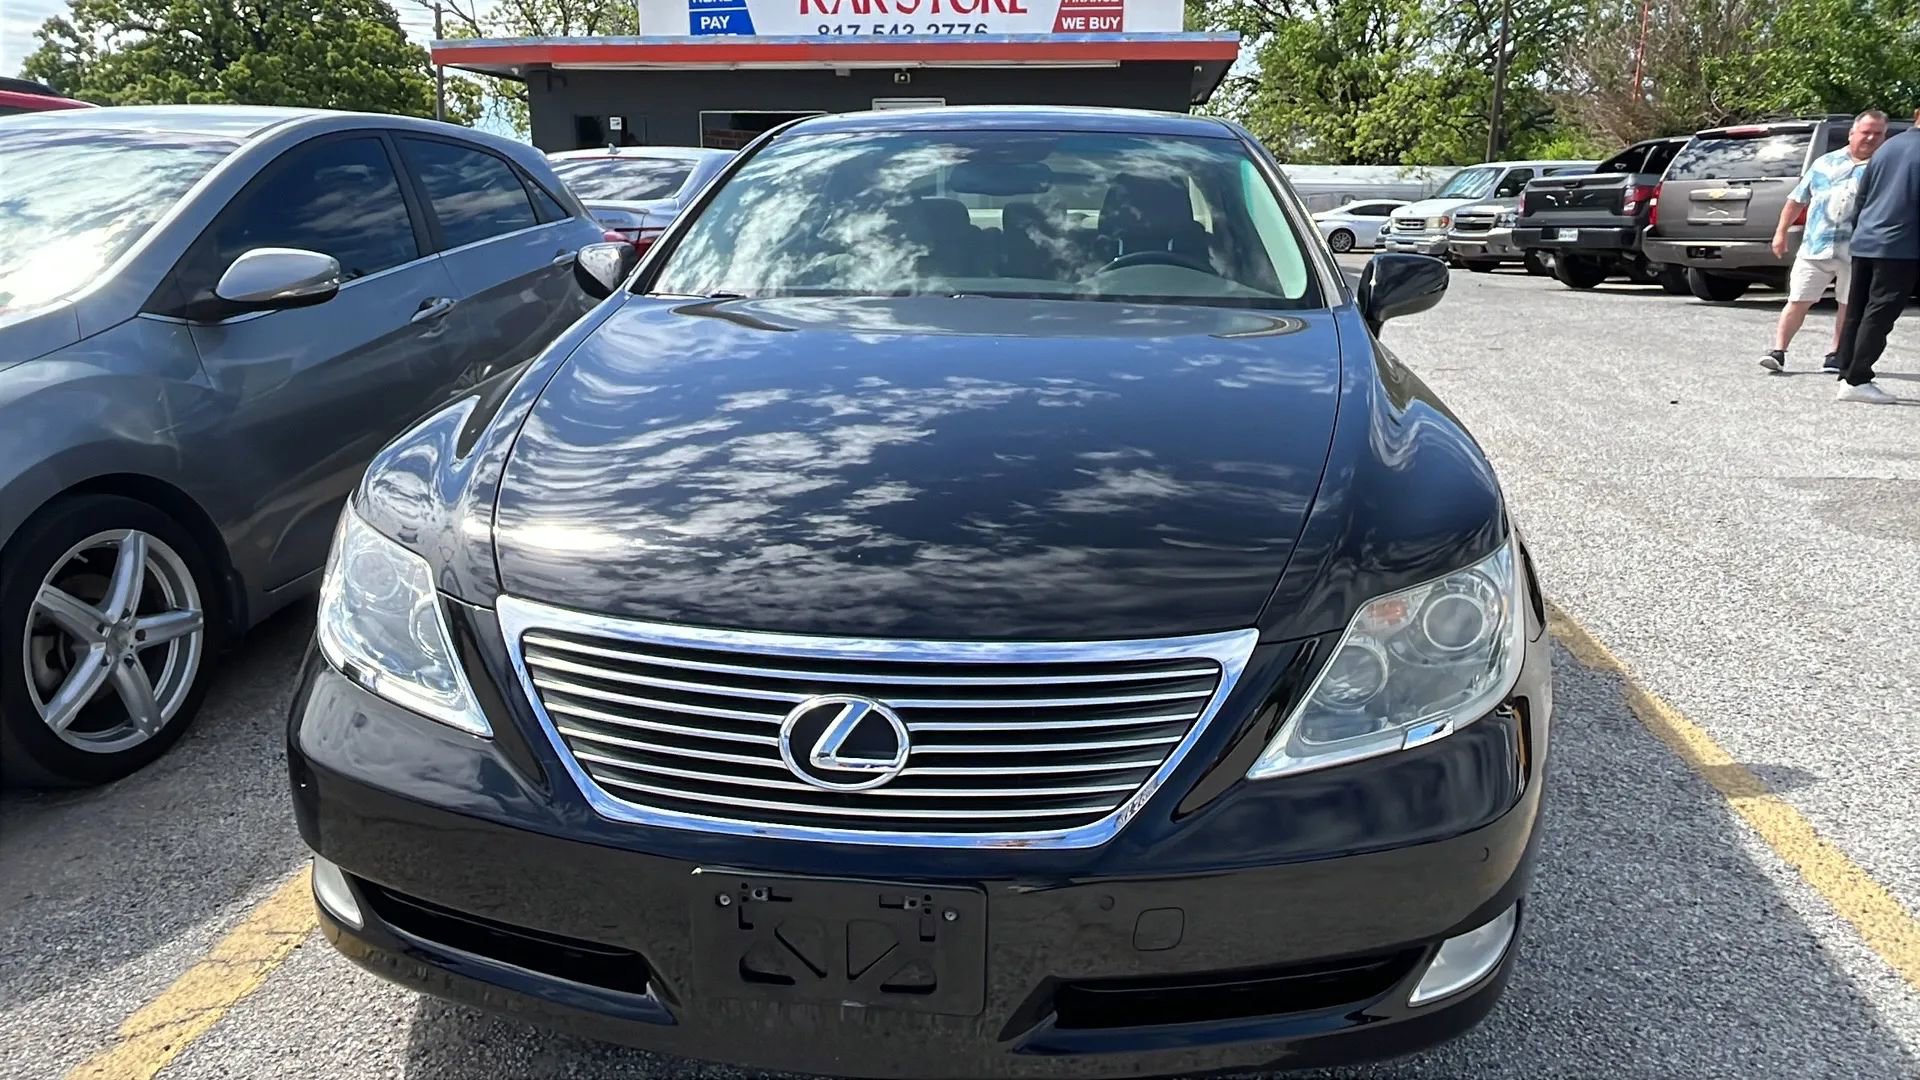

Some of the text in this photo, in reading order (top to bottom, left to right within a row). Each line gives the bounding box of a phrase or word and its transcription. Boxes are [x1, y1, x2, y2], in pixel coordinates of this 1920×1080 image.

[700, 15, 730, 30] PAY
[1061, 16, 1121, 30] WE BUY
